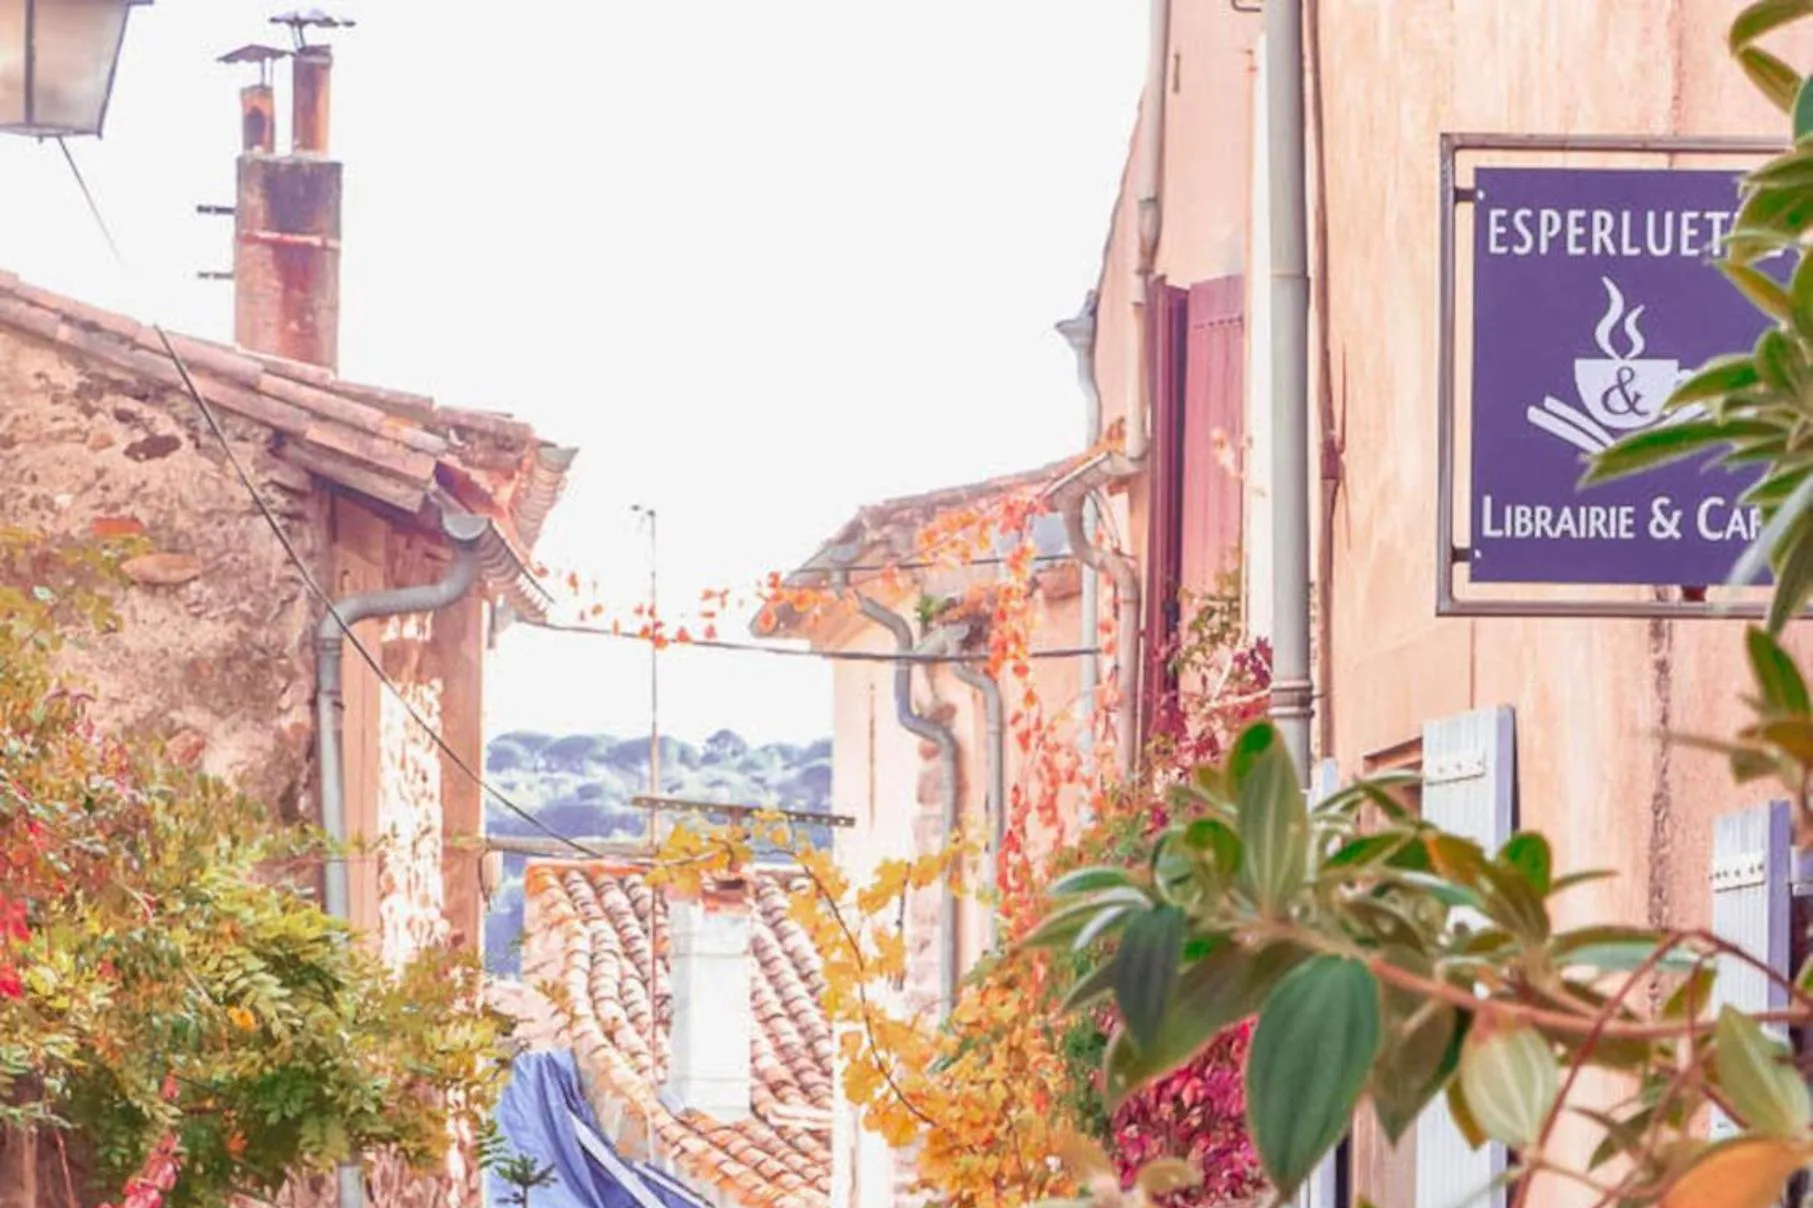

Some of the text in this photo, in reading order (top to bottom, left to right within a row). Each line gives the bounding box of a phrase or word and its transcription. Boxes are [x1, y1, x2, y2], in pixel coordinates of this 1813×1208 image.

[1488, 208, 1783, 257] ESPERLUET
[1602, 365, 1650, 417] &
[1648, 495, 1683, 540] &
[1696, 495, 1763, 541] CAF
